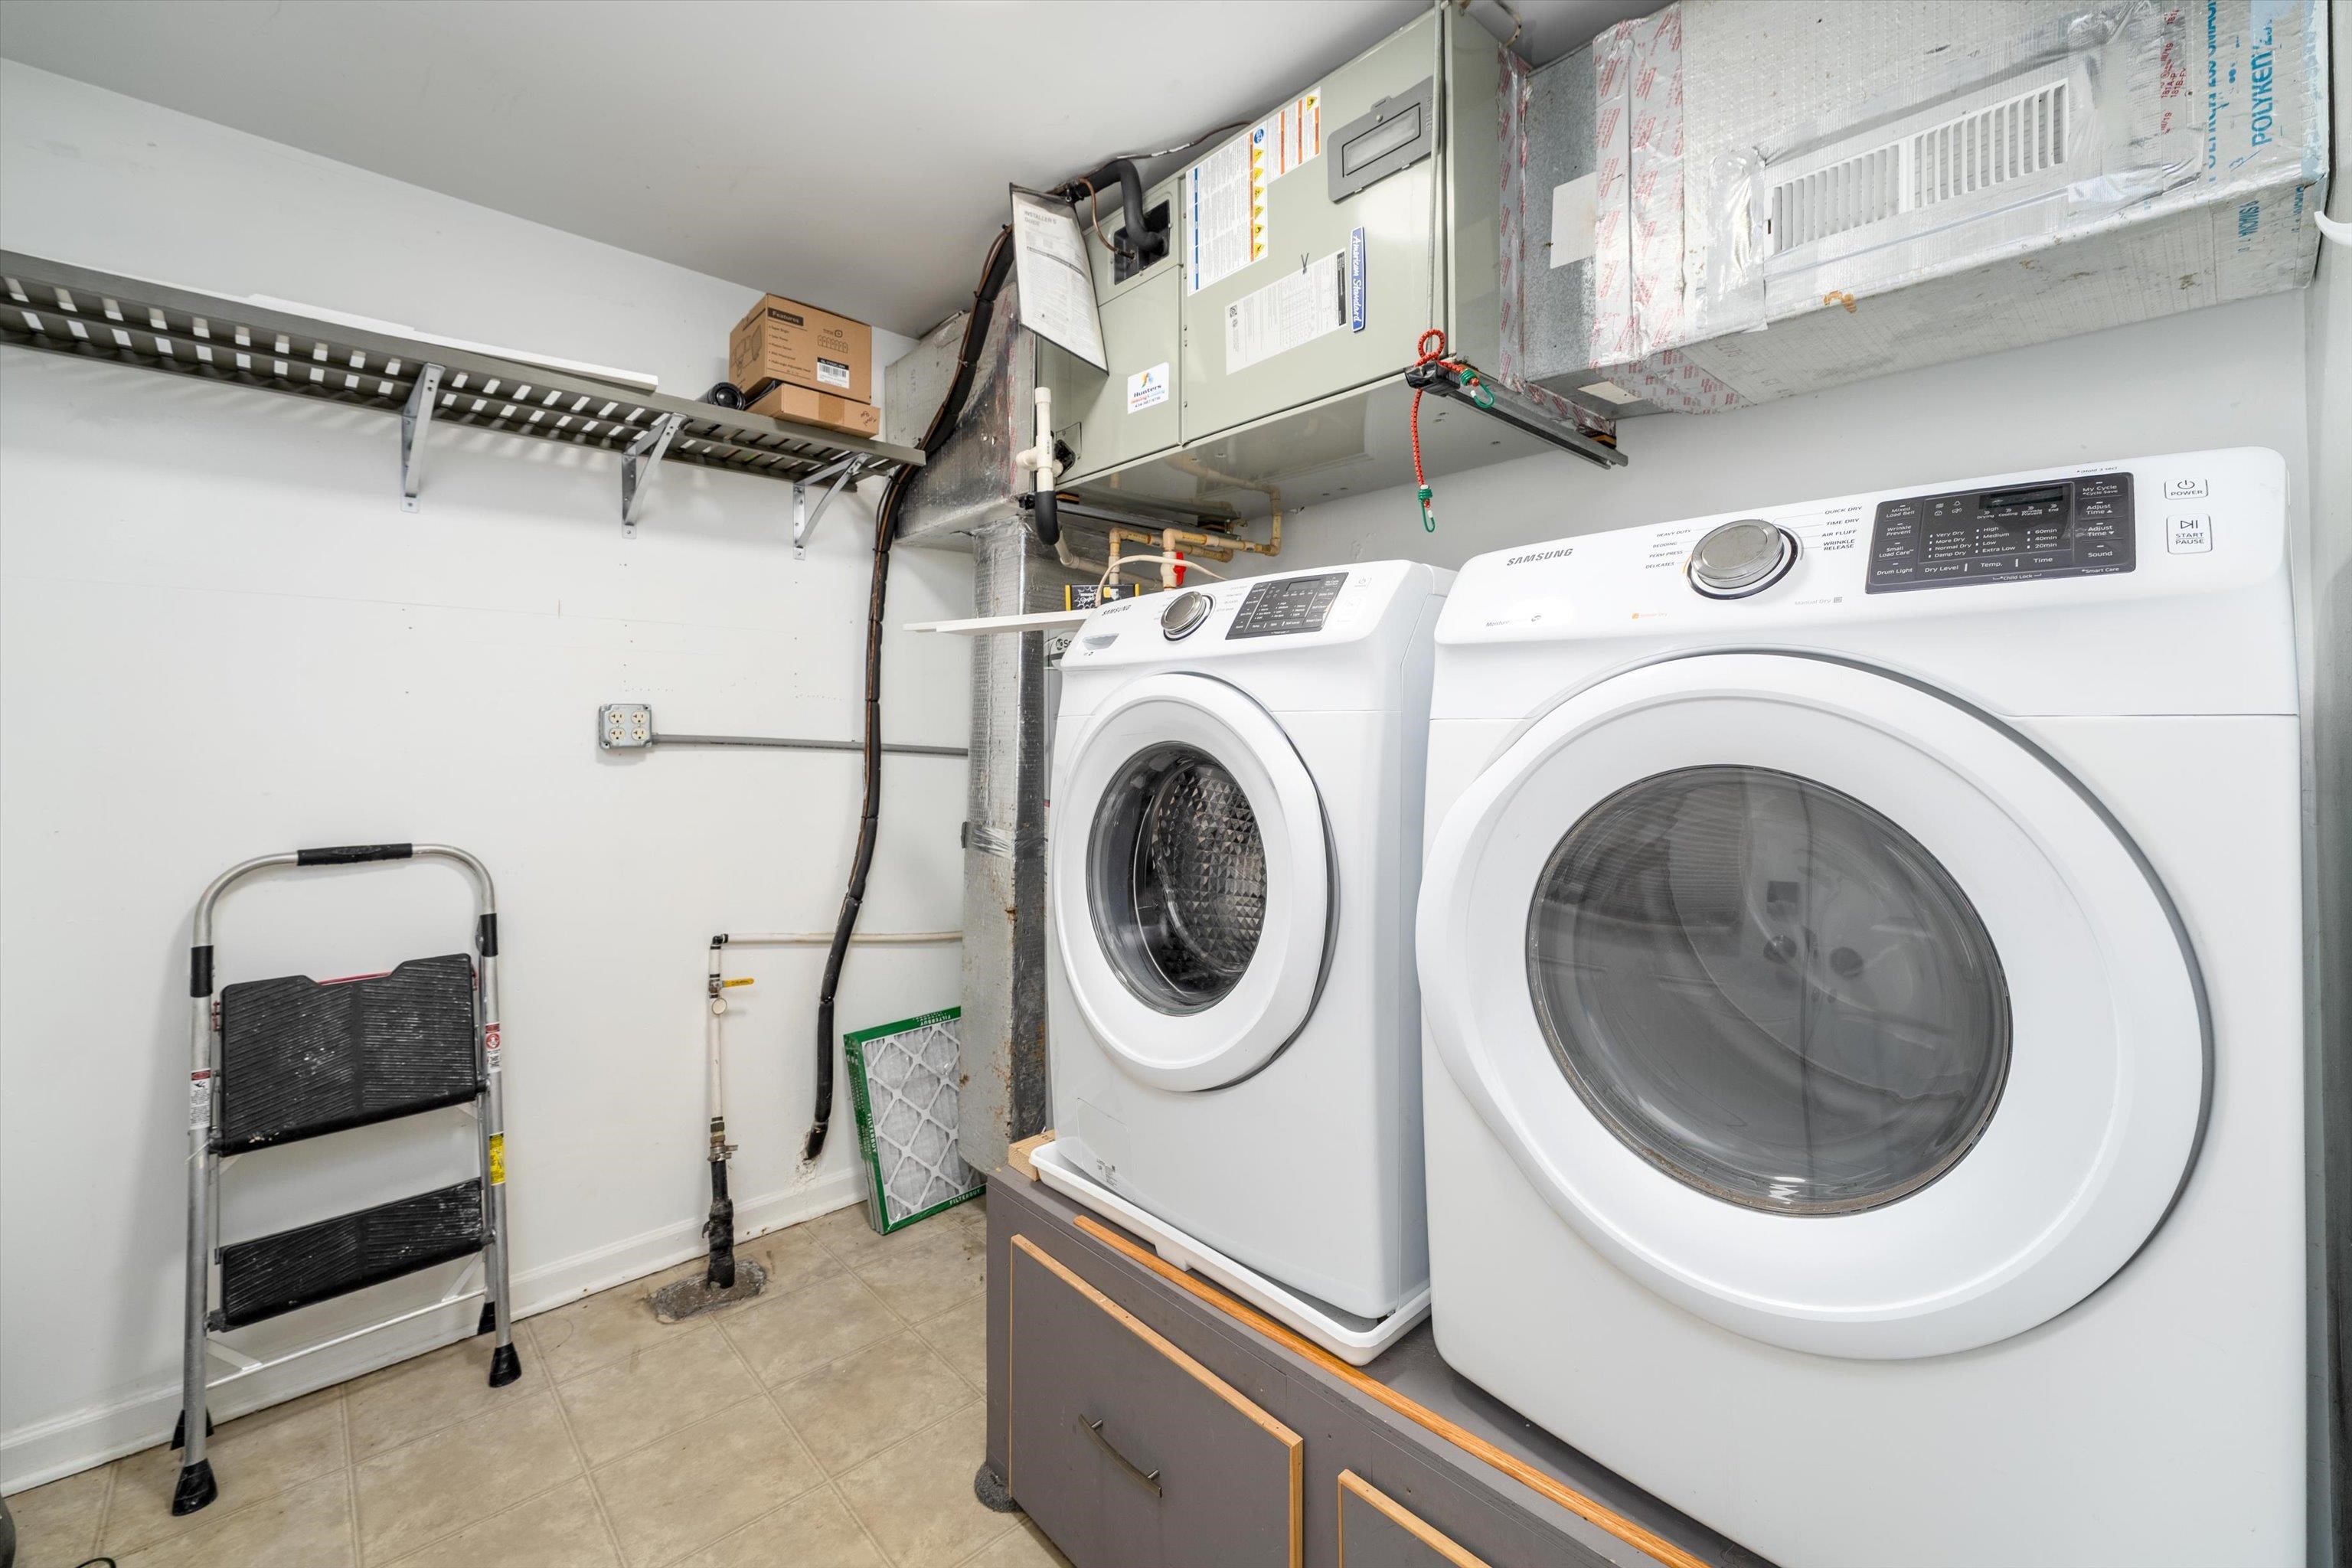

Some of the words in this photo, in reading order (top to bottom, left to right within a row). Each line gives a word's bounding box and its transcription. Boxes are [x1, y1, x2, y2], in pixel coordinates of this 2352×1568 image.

[1352, 235, 1361, 277] American
[1353, 279, 1362, 322] Standard
[772, 310, 800, 324] Features
[1134, 384, 1161, 397] Hunters
[1507, 548, 1573, 567] SAMSUNG
[1102, 604, 1132, 616] SAMSUNG
[867, 1112, 877, 1152] FILTERBUY
[949, 1189, 980, 1206] FILTERBUY
